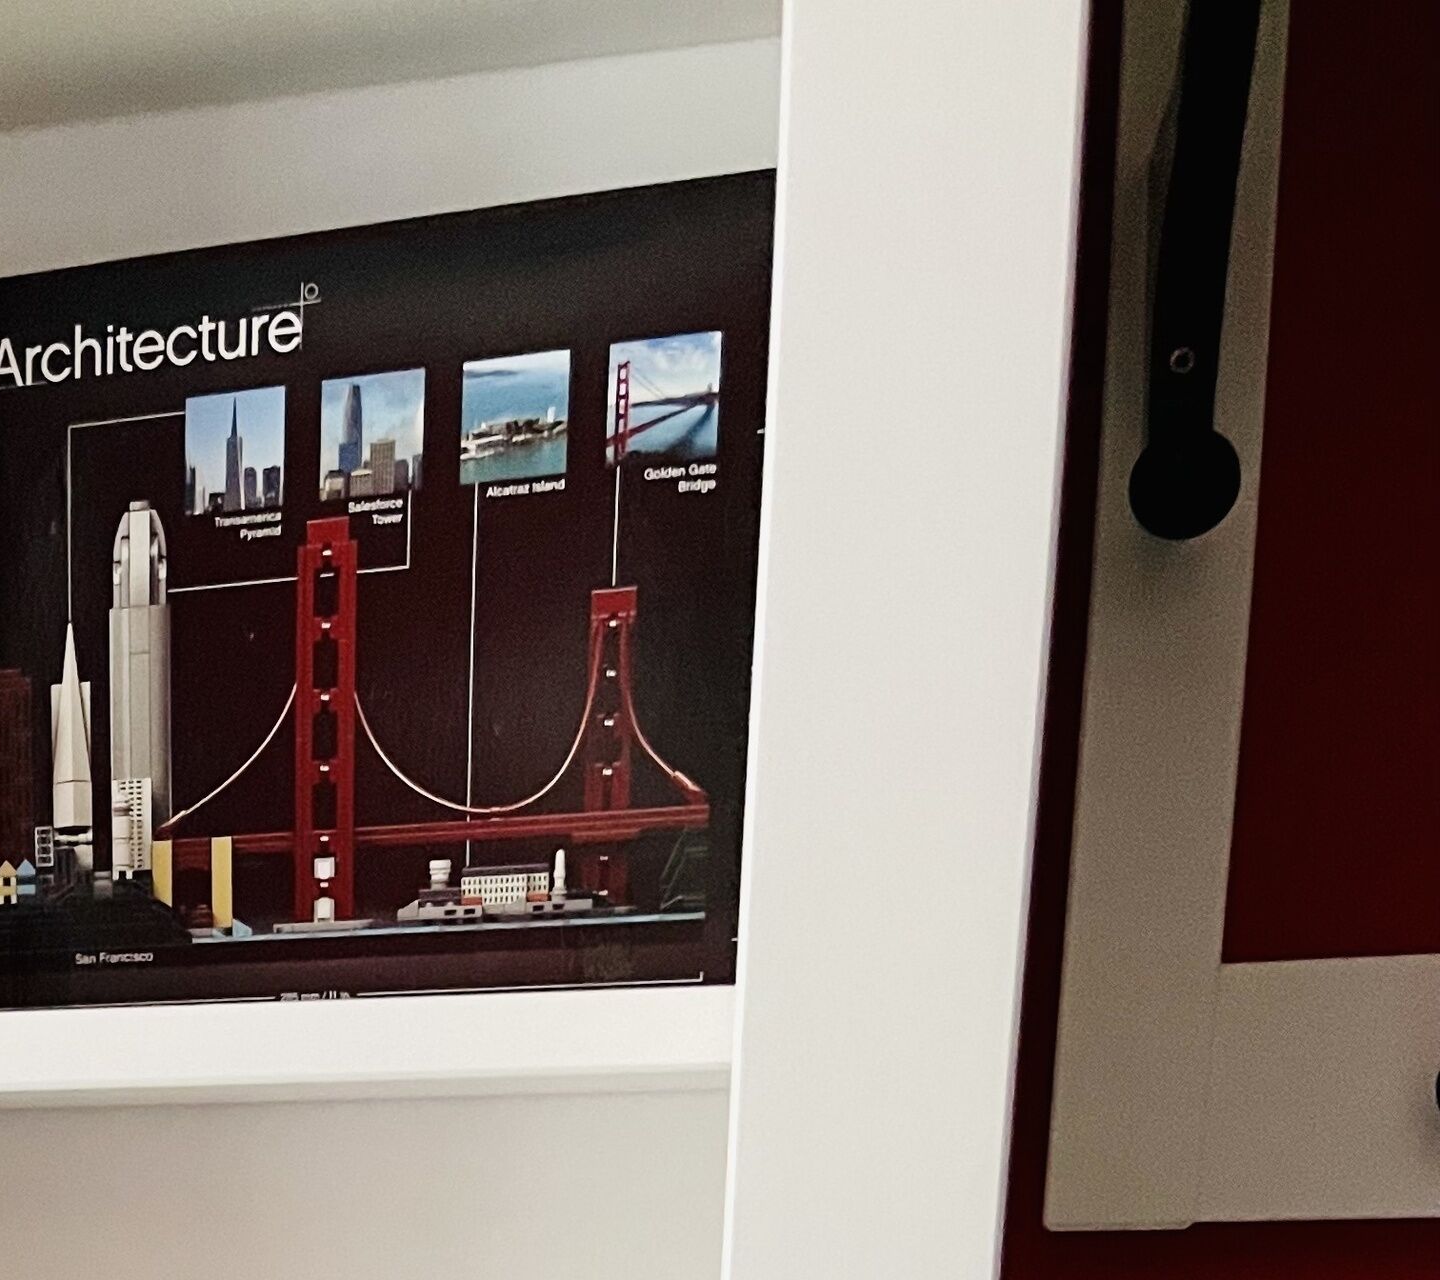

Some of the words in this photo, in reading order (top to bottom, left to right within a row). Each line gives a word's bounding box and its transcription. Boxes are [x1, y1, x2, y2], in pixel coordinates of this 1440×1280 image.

[644, 466, 686, 480] Golden
[688, 463, 717, 477] Gate
[486, 481, 530, 497] Alcatraz
[532, 478, 566, 493] Island
[678, 479, 716, 493] Bridge
[348, 498, 404, 514] Salesforce
[215, 512, 282, 527] Transamerica
[372, 513, 404, 525] Tower
[240, 525, 282, 541] Pyramid
[75, 952, 97, 965] San
[99, 951, 154, 964] Francisco
